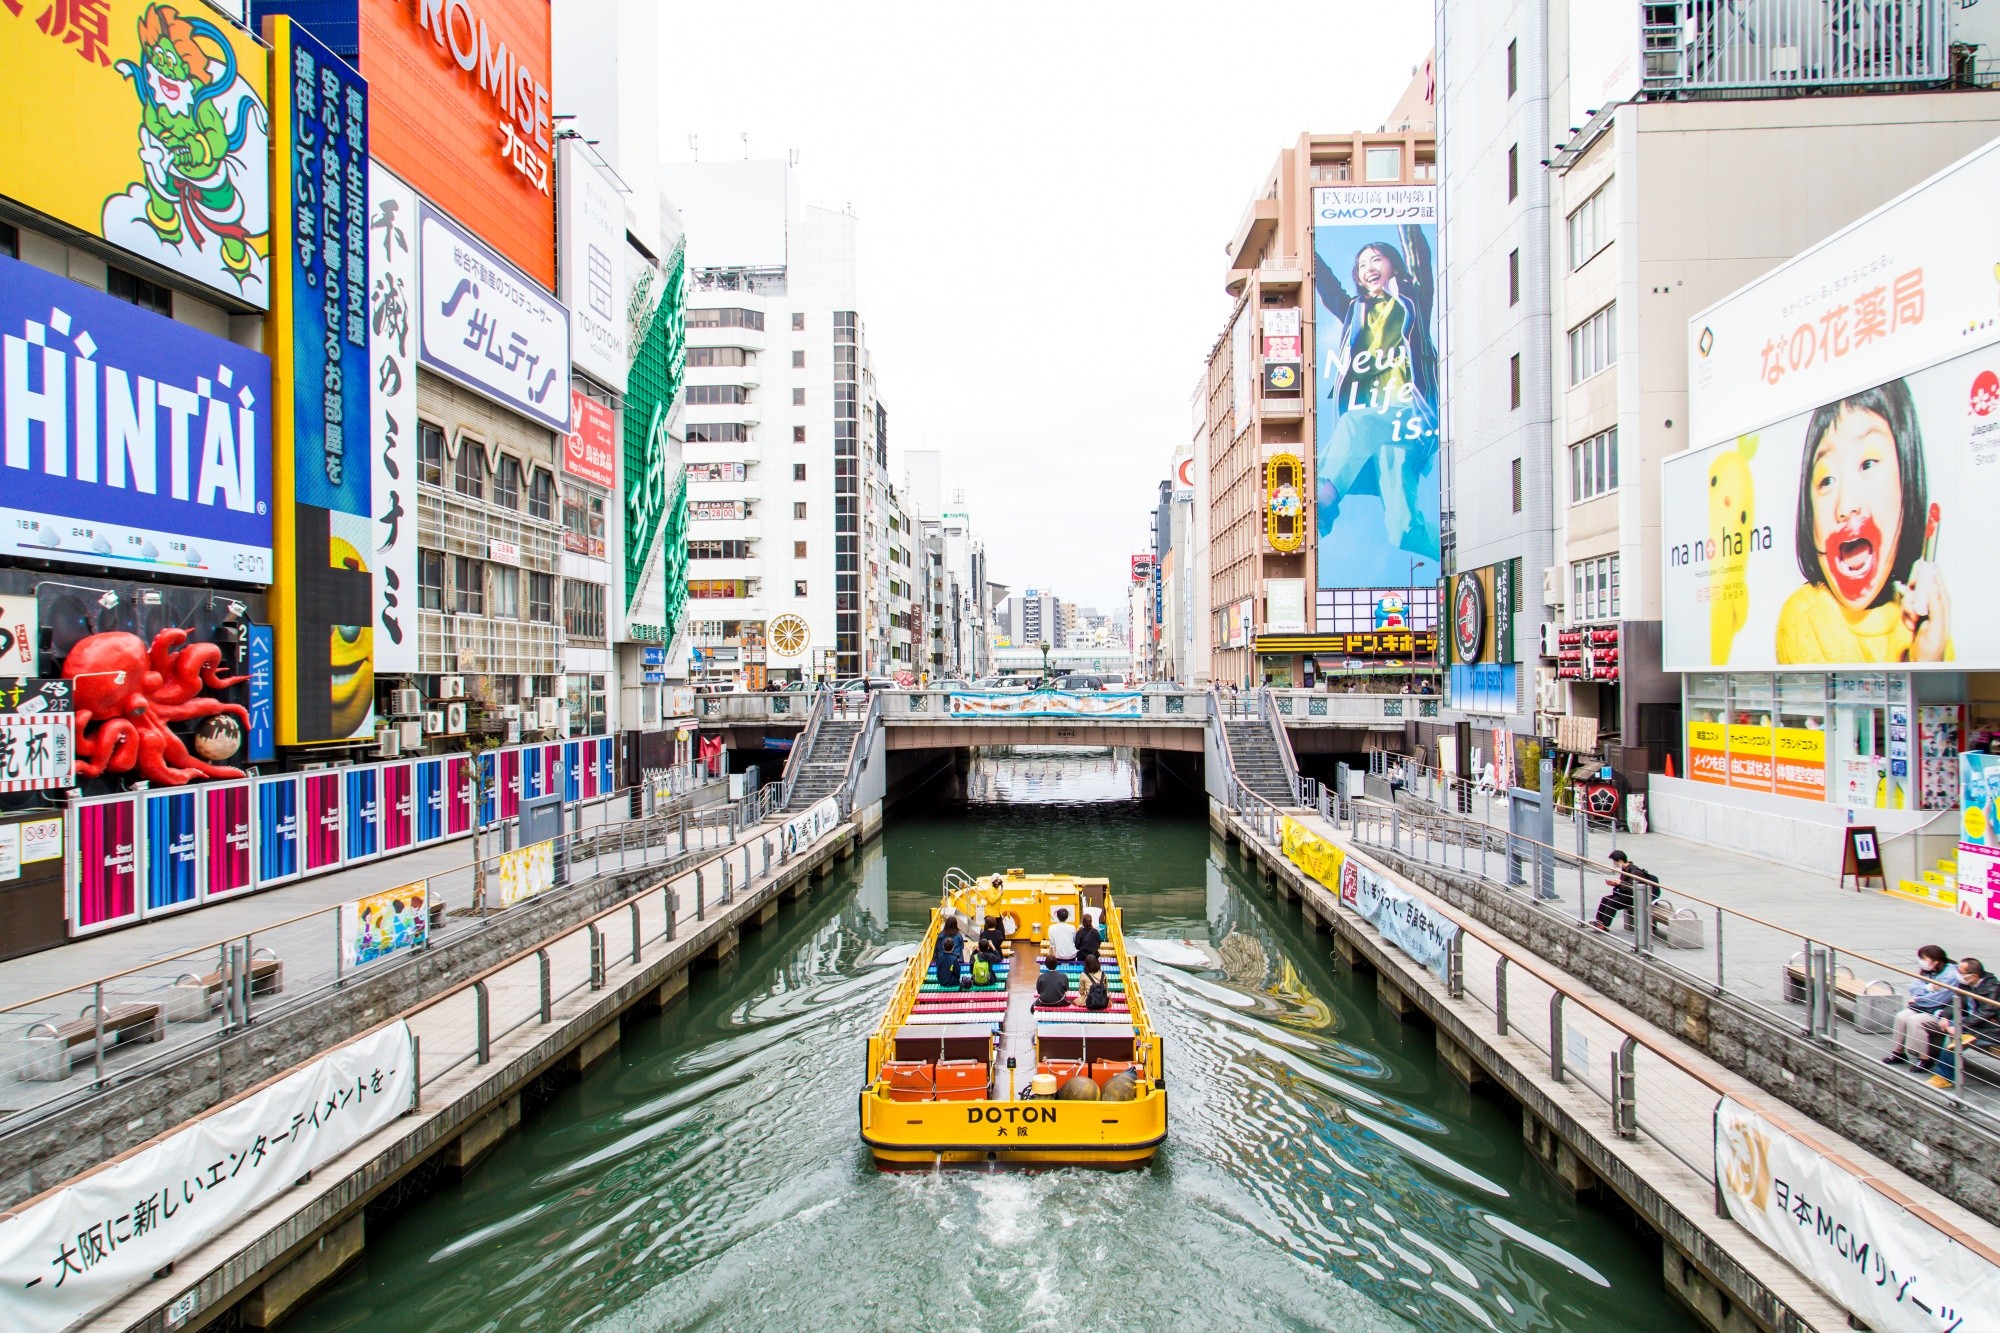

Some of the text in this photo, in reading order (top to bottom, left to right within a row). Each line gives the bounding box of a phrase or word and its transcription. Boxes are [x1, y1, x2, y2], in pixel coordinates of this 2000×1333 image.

[295, 45, 317, 286] 提供しています。
[498, 119, 550, 197] プロミス
[345, 84, 366, 347] 福祉・生活保護支援
[321, 66, 343, 485] 安心・快適に暮らせるお部屋を
[452, 245, 554, 325] 総合不動産のプロデューサー
[1760, 267, 1925, 386] なの花薬局
[1323, 346, 1406, 380] New
[1347, 377, 1414, 415] Life
[239, 624, 248, 663] 2F
[49, 698, 69, 712] 2F
[251, 636, 269, 748] ペンギンバー
[1470, 670, 1505, 691] LAWSON
[1729, 735, 1772, 747] オーガニックコスメ
[1780, 738, 1819, 751] ブランドコスメ
[967, 1106, 1058, 1124] DOTON
[52, 1067, 385, 1288] 大阪に新しいエンターテイメントを
